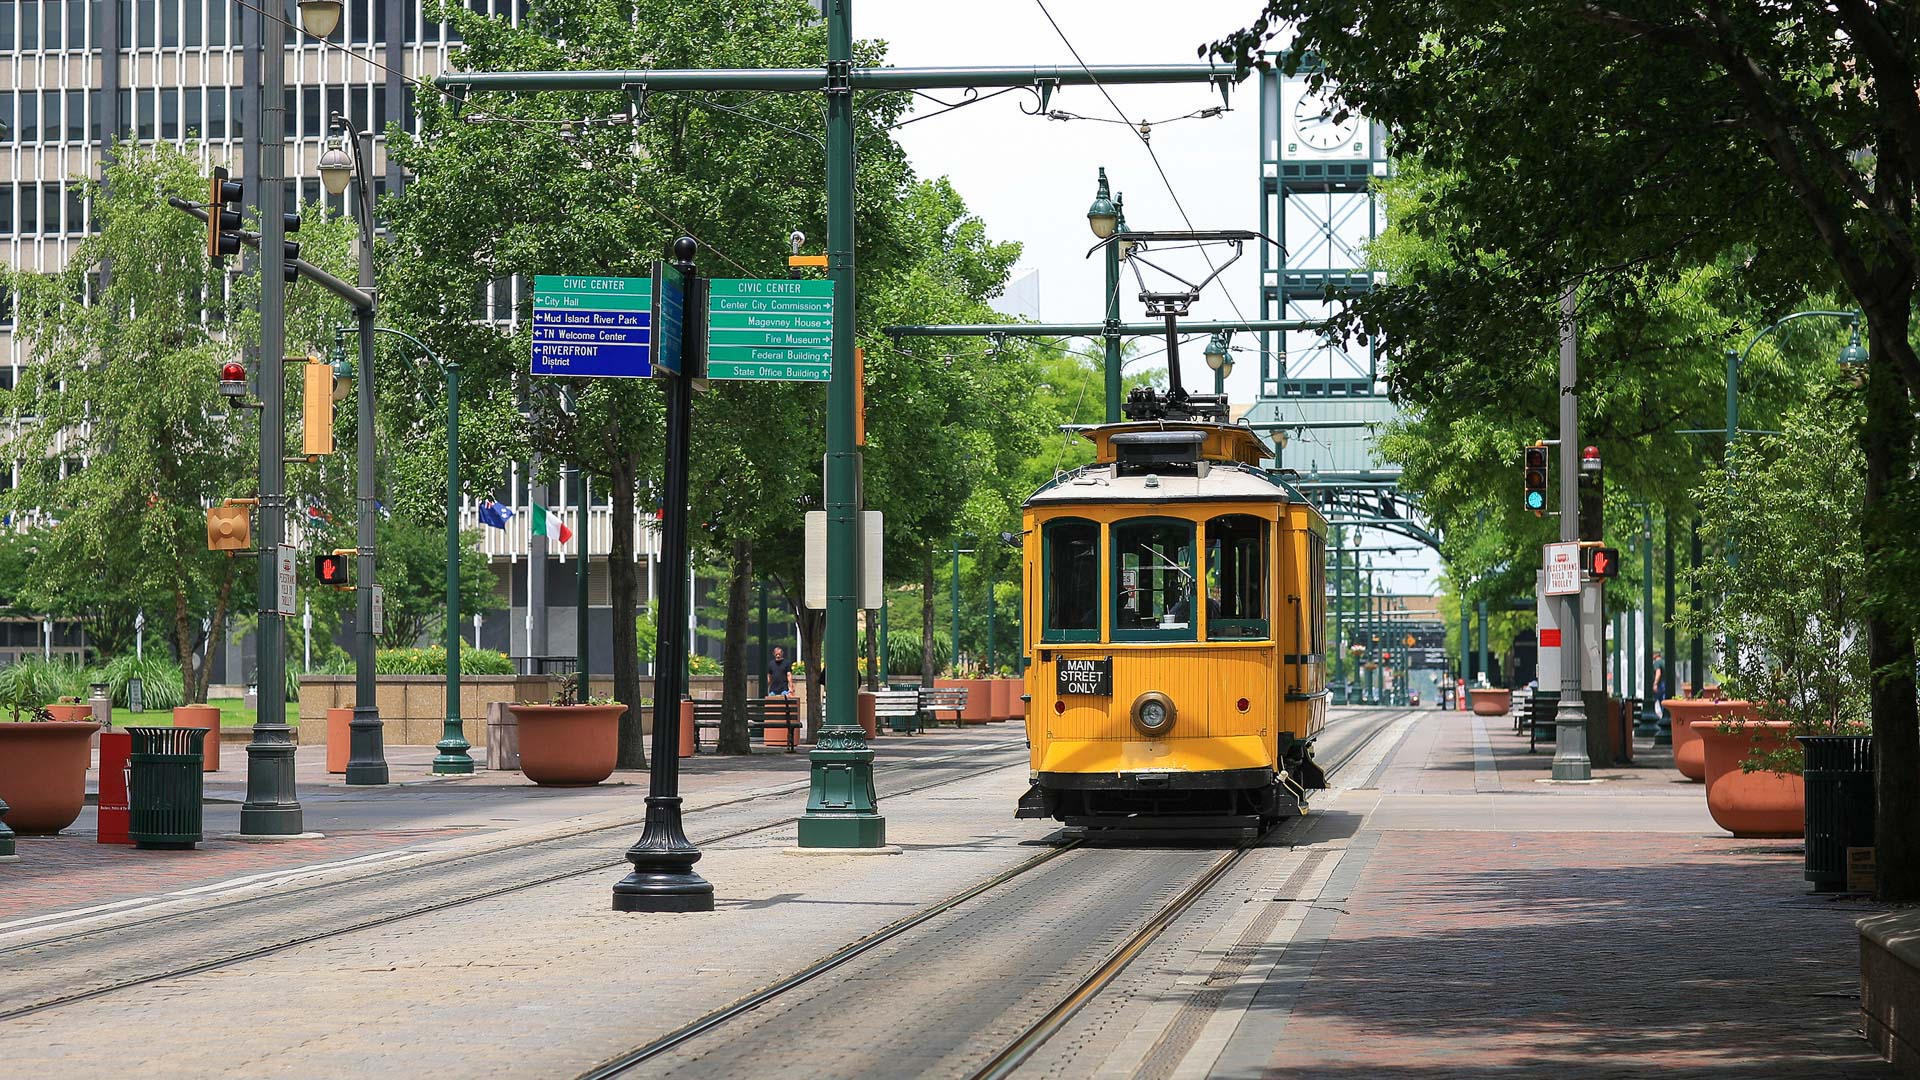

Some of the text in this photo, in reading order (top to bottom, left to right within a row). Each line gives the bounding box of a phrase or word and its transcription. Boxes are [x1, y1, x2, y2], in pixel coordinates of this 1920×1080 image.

[563, 279, 625, 290] CIVIC CENTER
[738, 282, 801, 293] CIVIC CENTER
[544, 296, 579, 307] City Hall
[720, 299, 822, 311] Center City Commission
[543, 313, 638, 325] Mud Island River Park
[794, 317, 821, 327] House
[543, 329, 627, 341] TN Welcome Center
[765, 333, 821, 344] Fire Museum
[542, 345, 598, 356] RIVERFRONT
[751, 349, 821, 363] Federal Building
[542, 356, 570, 366] District
[733, 366, 820, 379] State Office Building
[1546, 563, 1577, 572] PEDESTRIANS
[1067, 660, 1095, 671] MAIN
[1060, 670, 1104, 682] STREET
[1068, 682, 1097, 694] ONLY
